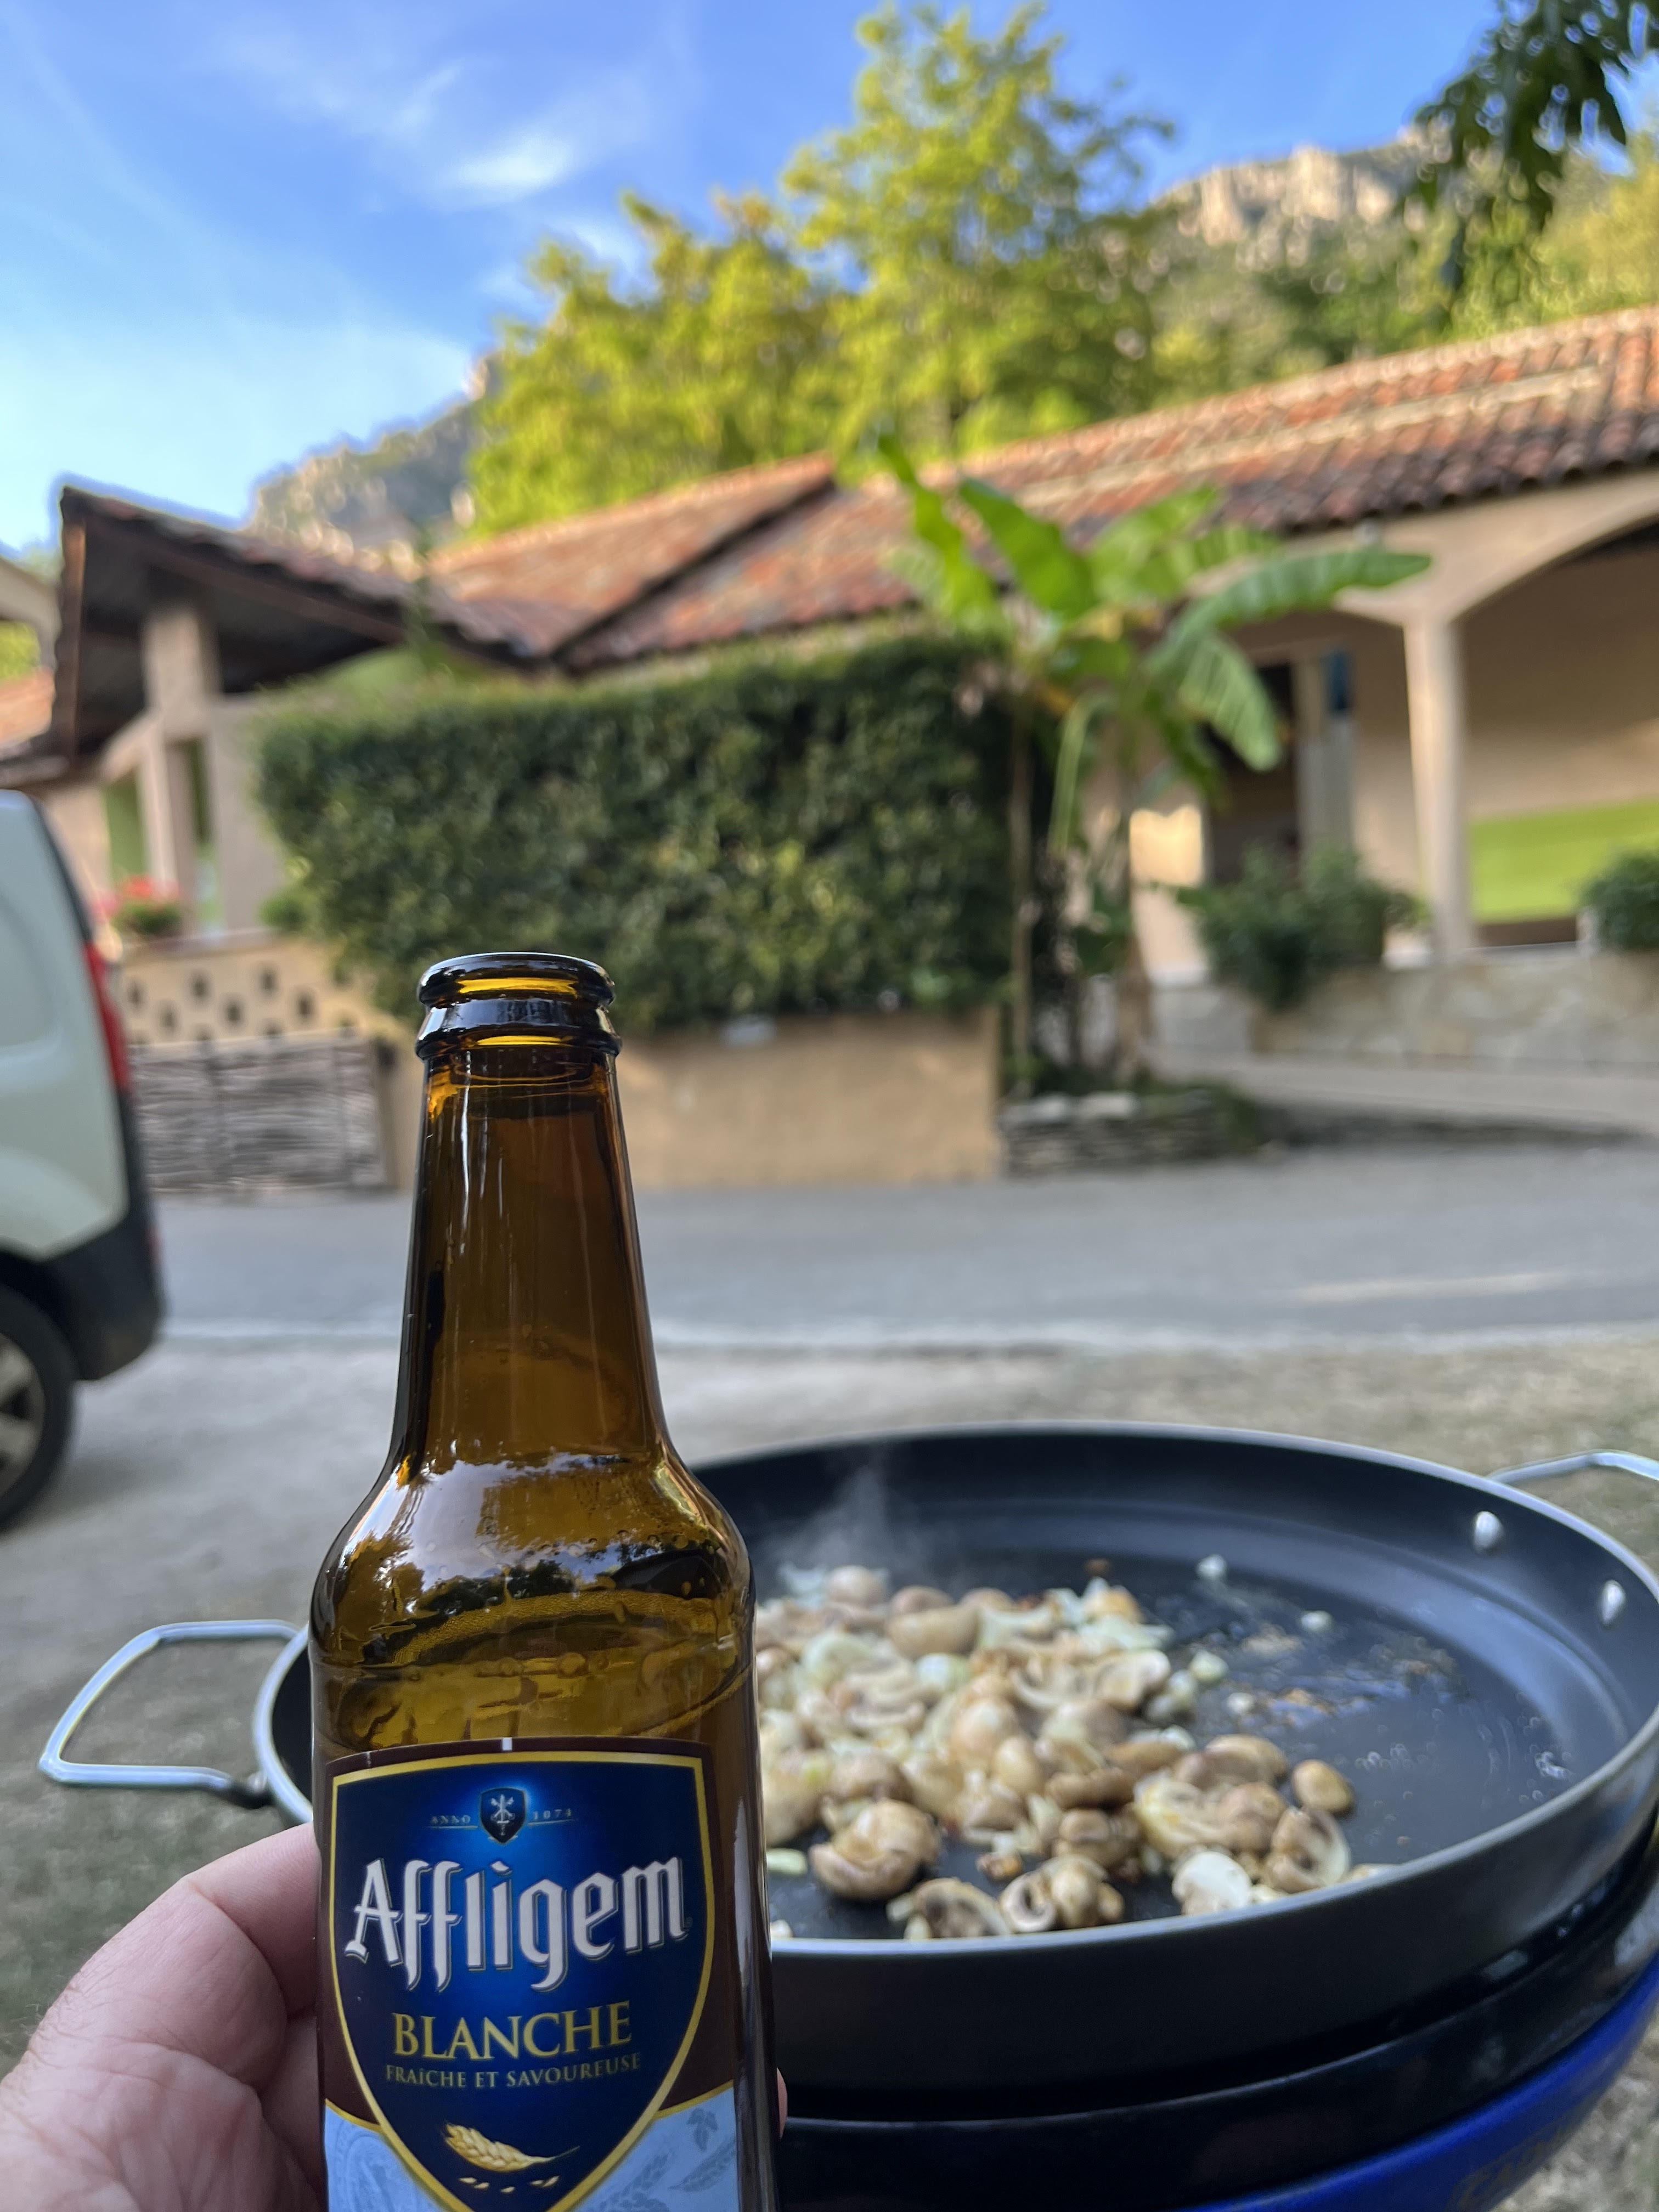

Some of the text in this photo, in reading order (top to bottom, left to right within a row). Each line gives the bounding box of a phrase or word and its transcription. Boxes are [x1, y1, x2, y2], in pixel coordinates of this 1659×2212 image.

[343, 1857, 688, 1991] Affligem
[391, 2000, 632, 2059] BLANCHE
[476, 2071, 499, 2087] ET
[506, 2052, 641, 2086] SAVOUREUSE
